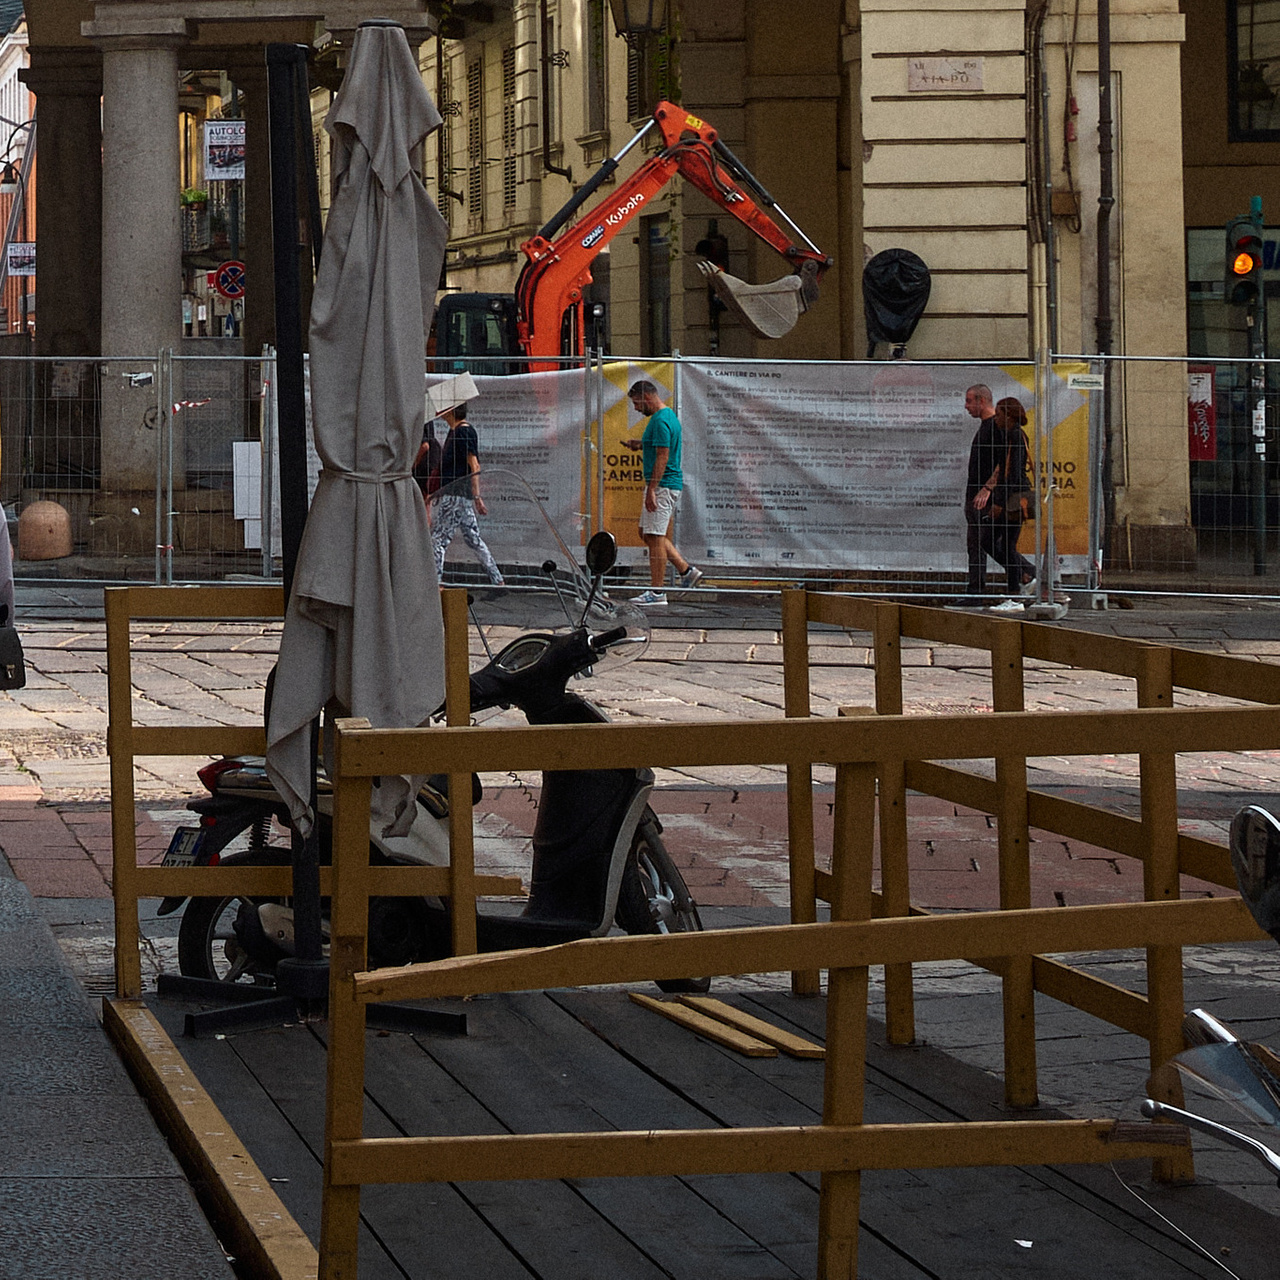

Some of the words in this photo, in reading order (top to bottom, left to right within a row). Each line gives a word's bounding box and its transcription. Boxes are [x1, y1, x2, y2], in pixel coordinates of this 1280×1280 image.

[605, 193, 645, 226] Kubota
[715, 370, 748, 378] CANTIERE
[602, 454, 644, 468] ORIN
[1024, 461, 1077, 475] ORINO
